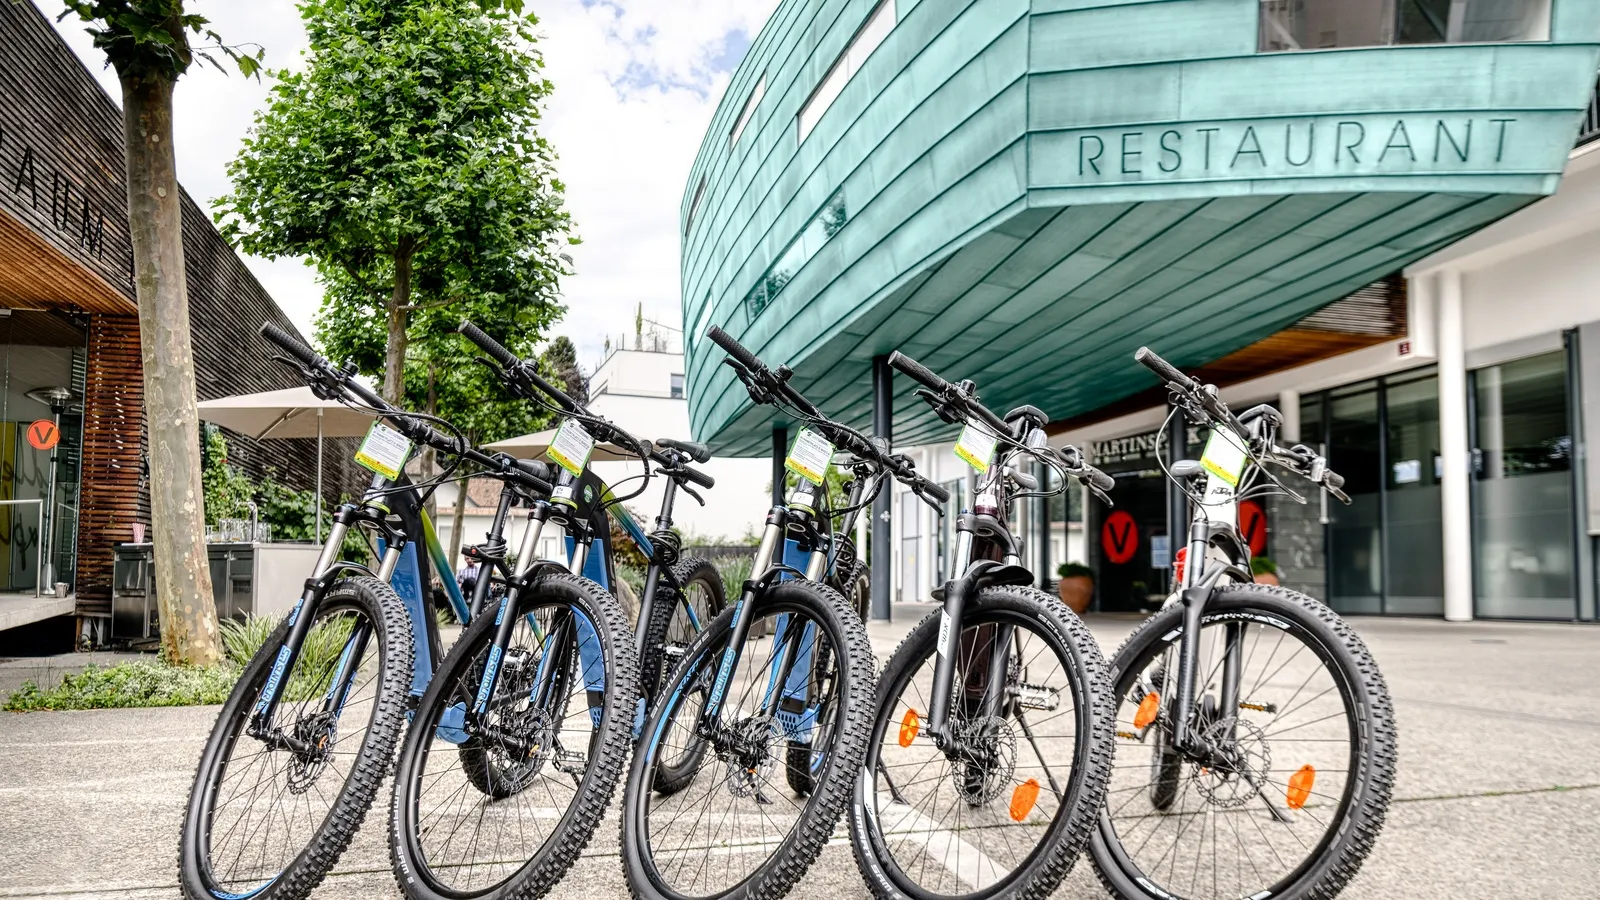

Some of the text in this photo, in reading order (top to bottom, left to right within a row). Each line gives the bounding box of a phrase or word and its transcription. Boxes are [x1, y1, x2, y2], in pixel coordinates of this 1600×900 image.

[1078, 118, 1518, 176] RESTAURANT
[0, 119, 104, 262] AUM
[1107, 520, 1132, 555] V
[394, 784, 402, 839] SMART
[853, 804, 873, 859] SMART
[870, 863, 893, 892] SAM
